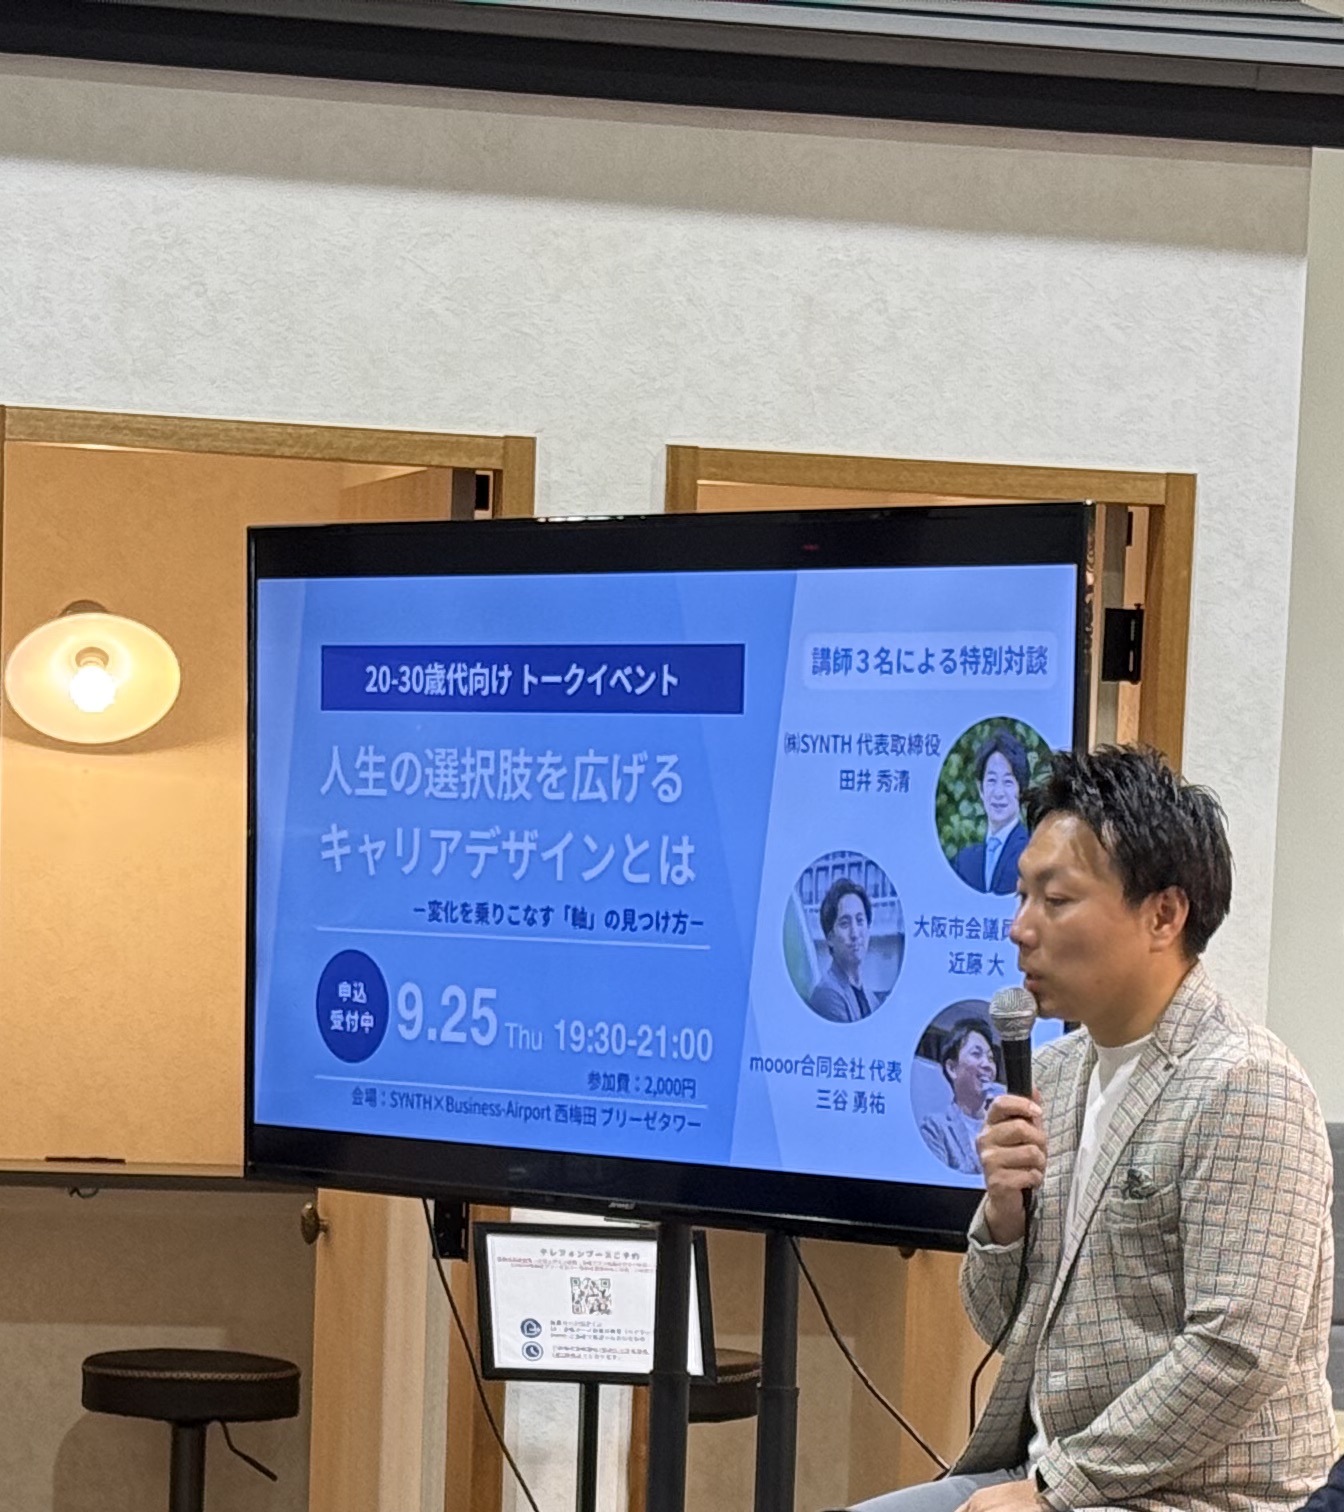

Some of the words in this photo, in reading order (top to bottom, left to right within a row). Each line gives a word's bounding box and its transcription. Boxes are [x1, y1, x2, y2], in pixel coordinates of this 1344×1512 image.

[365, 662, 513, 697] 20-30歳代向け
[522, 663, 679, 697] トークイベント
[856, 733, 941, 757] 代表取締役
[320, 745, 684, 804] 人生の選択肢を広げる
[840, 768, 871, 793] 田井
[320, 823, 697, 886] キャリアデザインとは
[948, 951, 983, 976] 近藤
[987, 951, 1005, 977] 大
[338, 980, 367, 1004] 申込
[330, 1009, 374, 1034] 受付中
[397, 981, 498, 1046] 9.25
[504, 1022, 543, 1052] Thu
[554, 1019, 714, 1062] 19:30-21:00
[749, 1054, 866, 1080] mooor合同会社
[869, 1058, 902, 1083] 代表
[816, 1088, 848, 1112] 三谷
[554, 1104, 597, 1127] 西梅田
